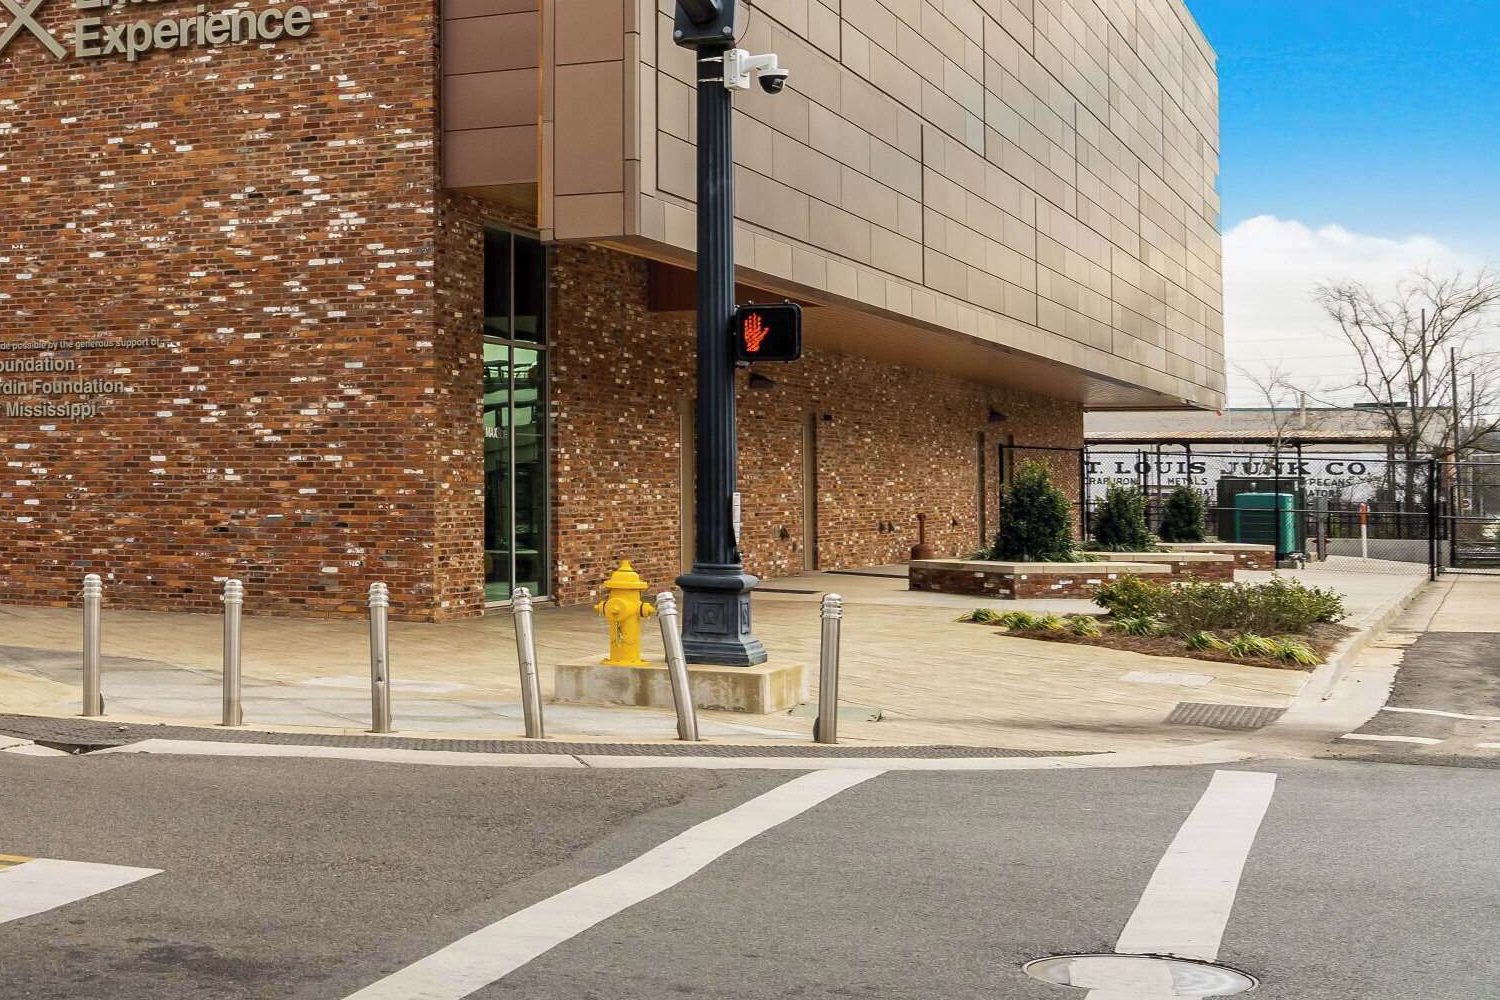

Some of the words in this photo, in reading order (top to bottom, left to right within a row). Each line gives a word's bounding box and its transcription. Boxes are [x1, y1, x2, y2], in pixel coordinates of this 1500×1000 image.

[75, 4, 312, 62] Experience
[48, 341, 58, 351] by
[60, 339, 73, 348] the
[75, 340, 113, 350] generous
[116, 338, 149, 349] support
[32, 379, 124, 395] Foundation
[6, 401, 96, 419] Mississippi
[1115, 461, 1206, 474] LOUIS
[1221, 461, 1311, 475] JUNK
[1326, 462, 1371, 475] CO.
[1310, 478, 1352, 487] PECANS
[1307, 489, 1342, 498] ATORS
